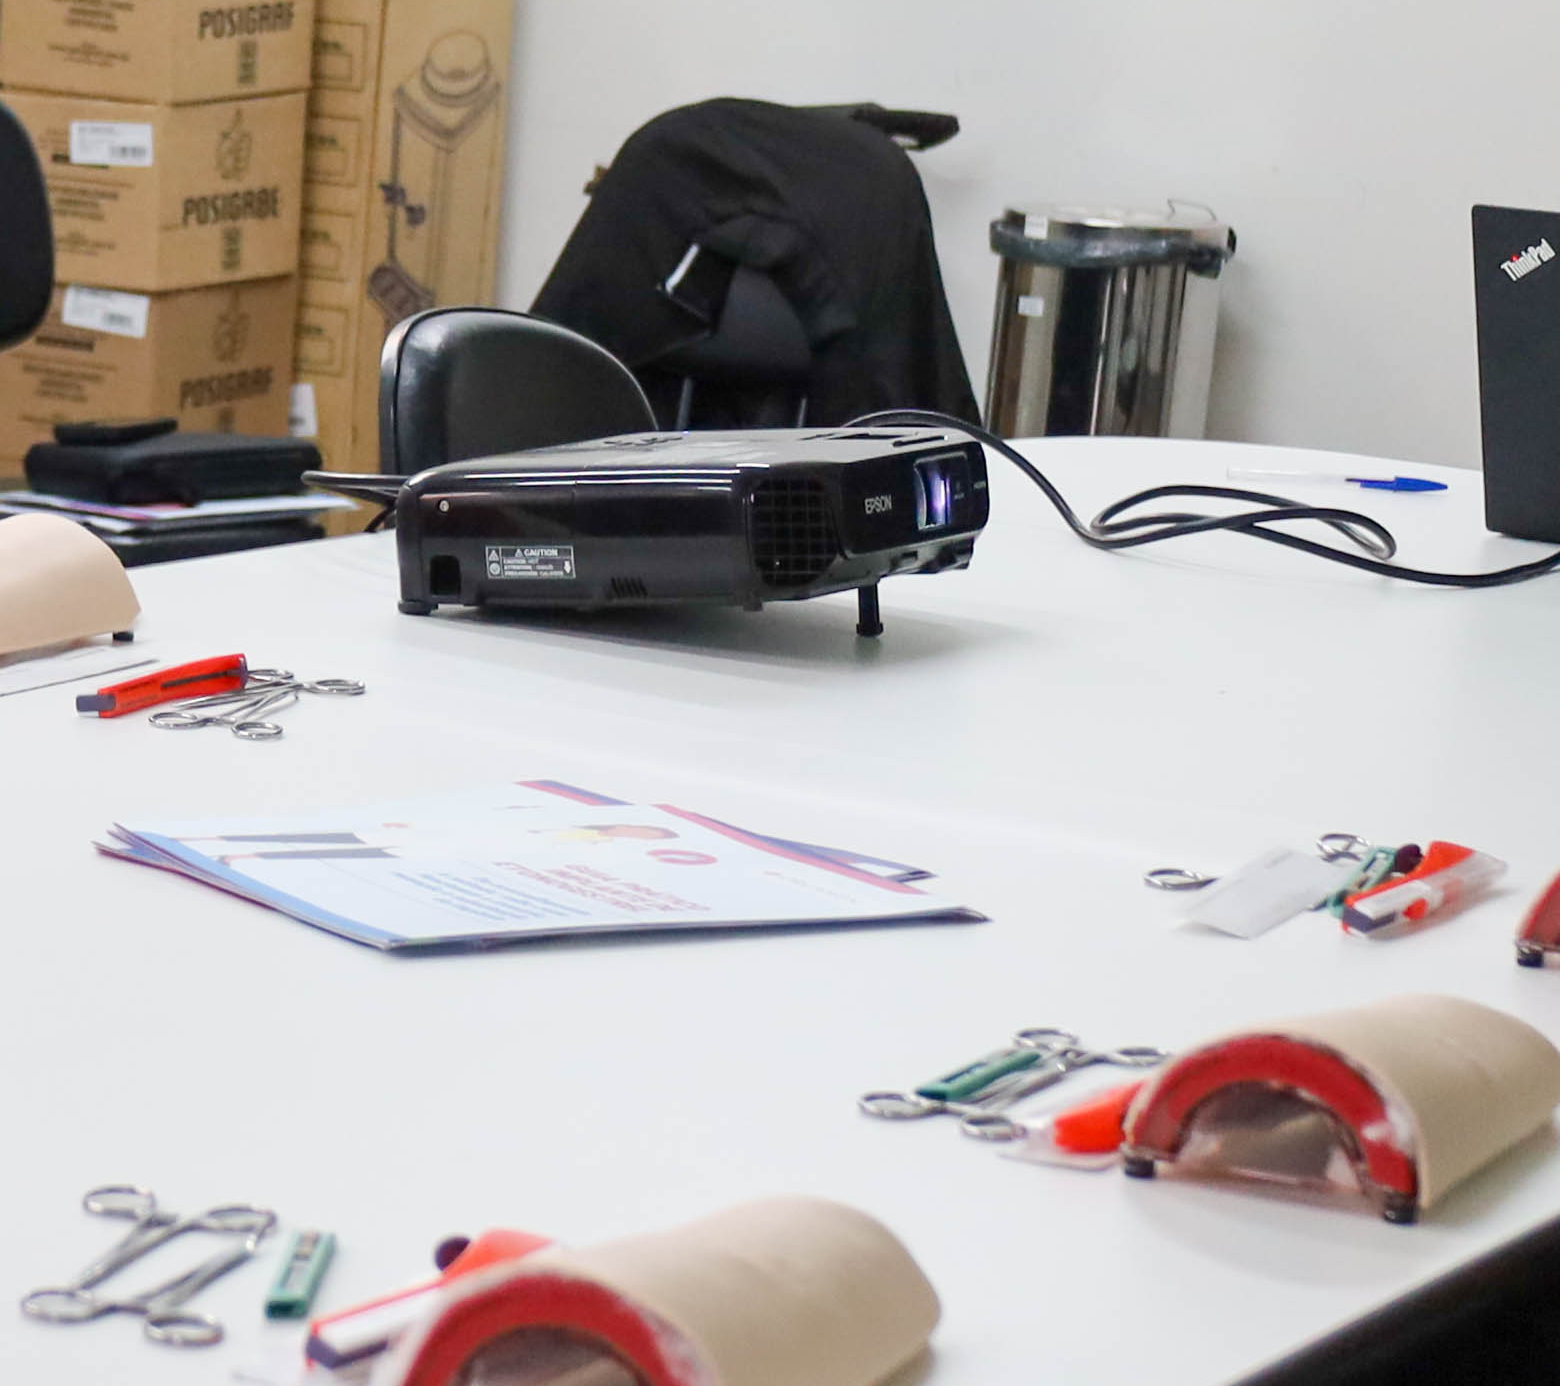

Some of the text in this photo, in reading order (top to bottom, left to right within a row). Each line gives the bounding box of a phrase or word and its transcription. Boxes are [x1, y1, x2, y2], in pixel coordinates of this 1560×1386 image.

[197, 1, 295, 41] POSIGRAF
[1500, 237, 1556, 282] ThinkPad
[864, 494, 893, 515] EPSON
[523, 548, 558, 557] CAUTION
